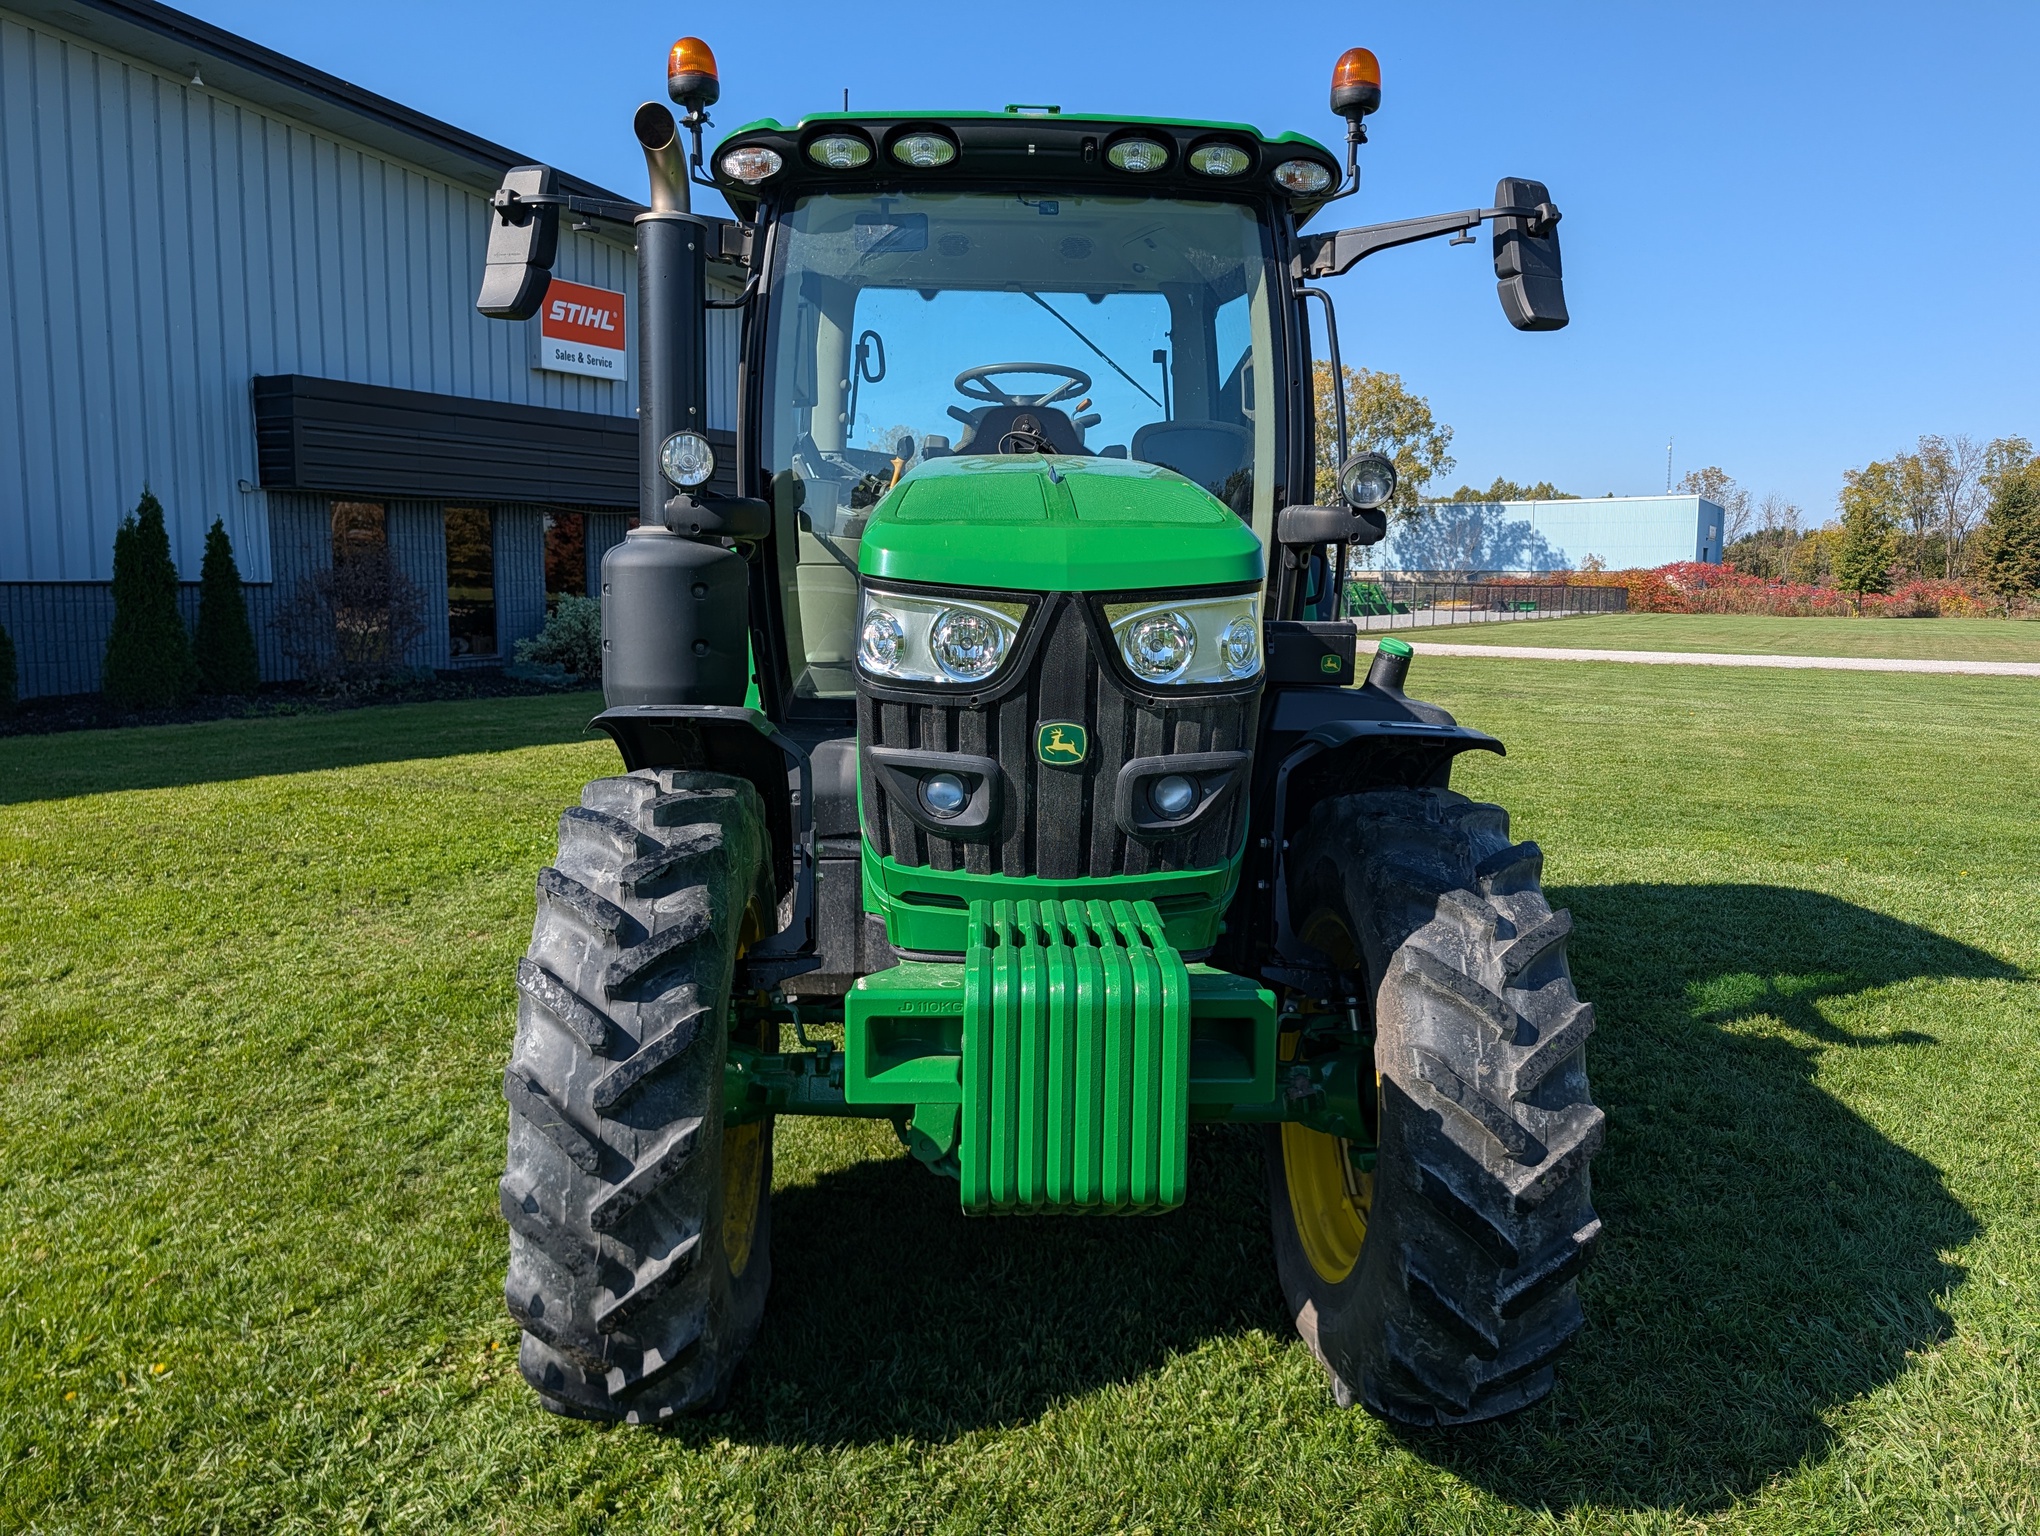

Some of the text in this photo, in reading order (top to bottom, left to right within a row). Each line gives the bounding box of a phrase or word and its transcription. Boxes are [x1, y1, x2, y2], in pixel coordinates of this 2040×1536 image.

[549, 300, 615, 331] STIHL
[555, 349, 613, 368] Sales & Service
